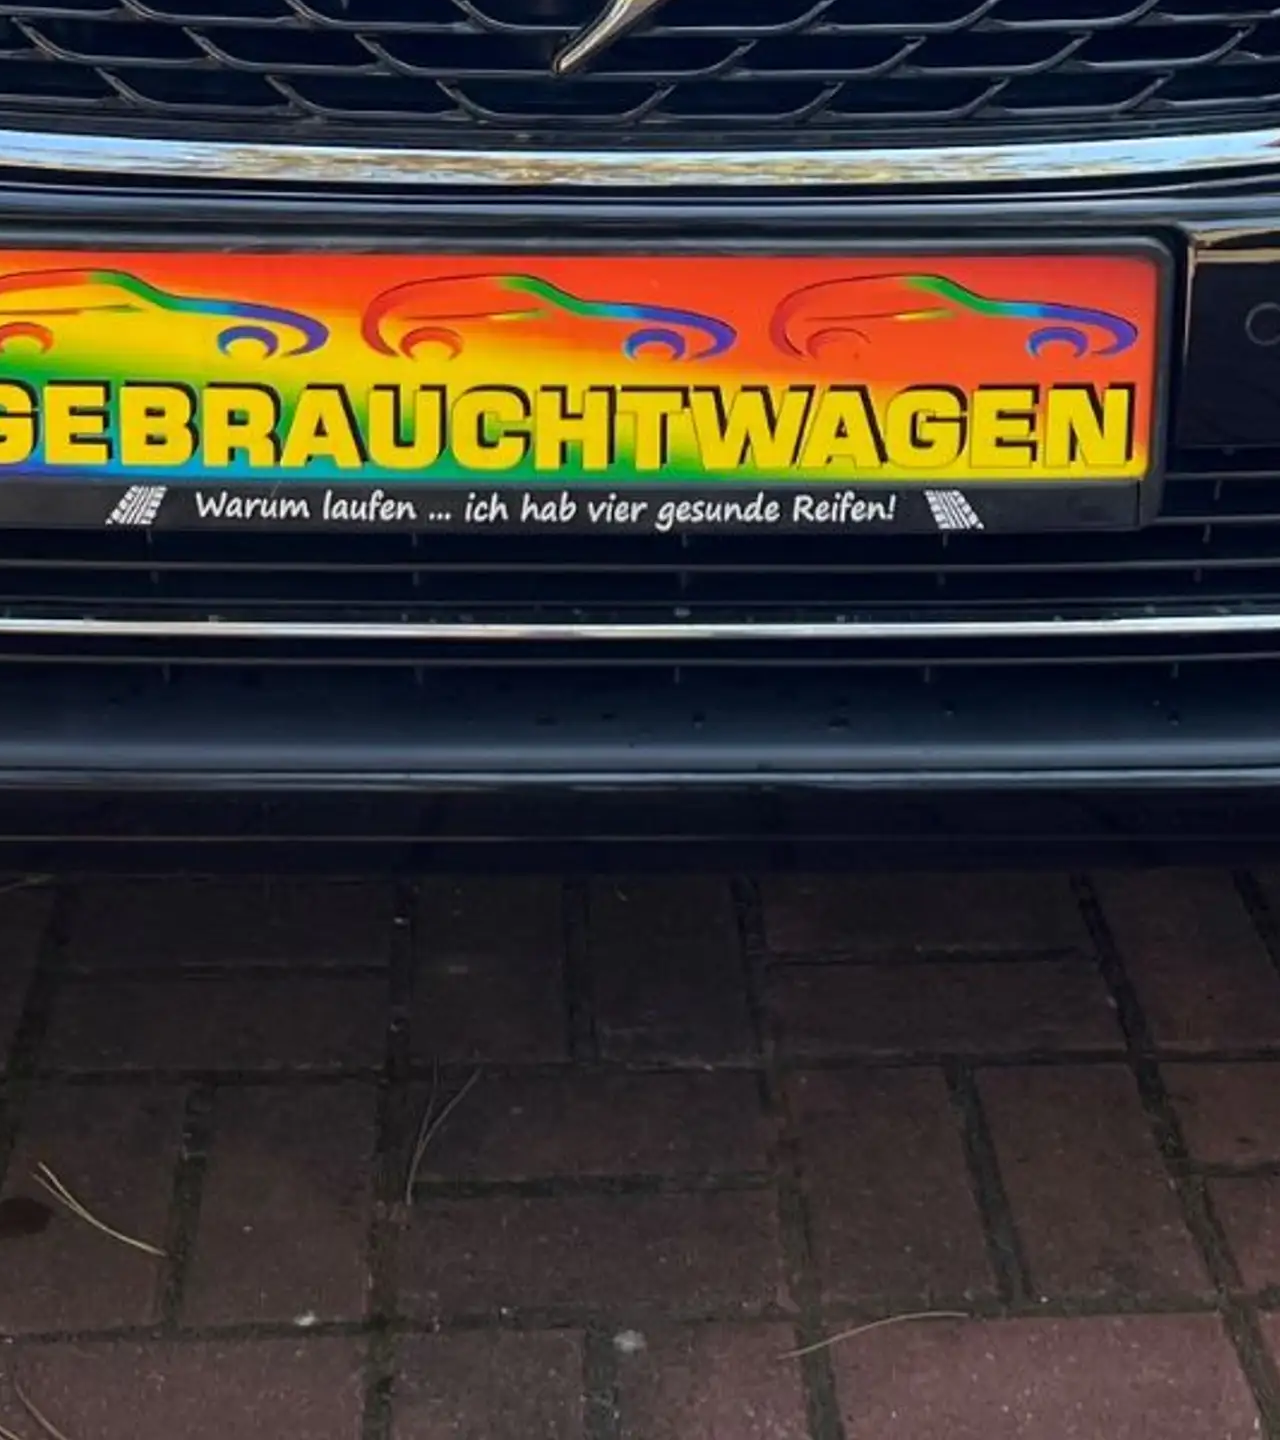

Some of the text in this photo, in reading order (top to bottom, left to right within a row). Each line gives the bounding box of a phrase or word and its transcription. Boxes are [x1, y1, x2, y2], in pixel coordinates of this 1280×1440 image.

[195, 489, 310, 520] Warum
[322, 488, 418, 523] laufen
[464, 491, 510, 523] ich
[519, 489, 578, 524] hab
[587, 491, 649, 524] vier
[654, 490, 782, 532] gesunde
[792, 490, 897, 524] Reifen!
